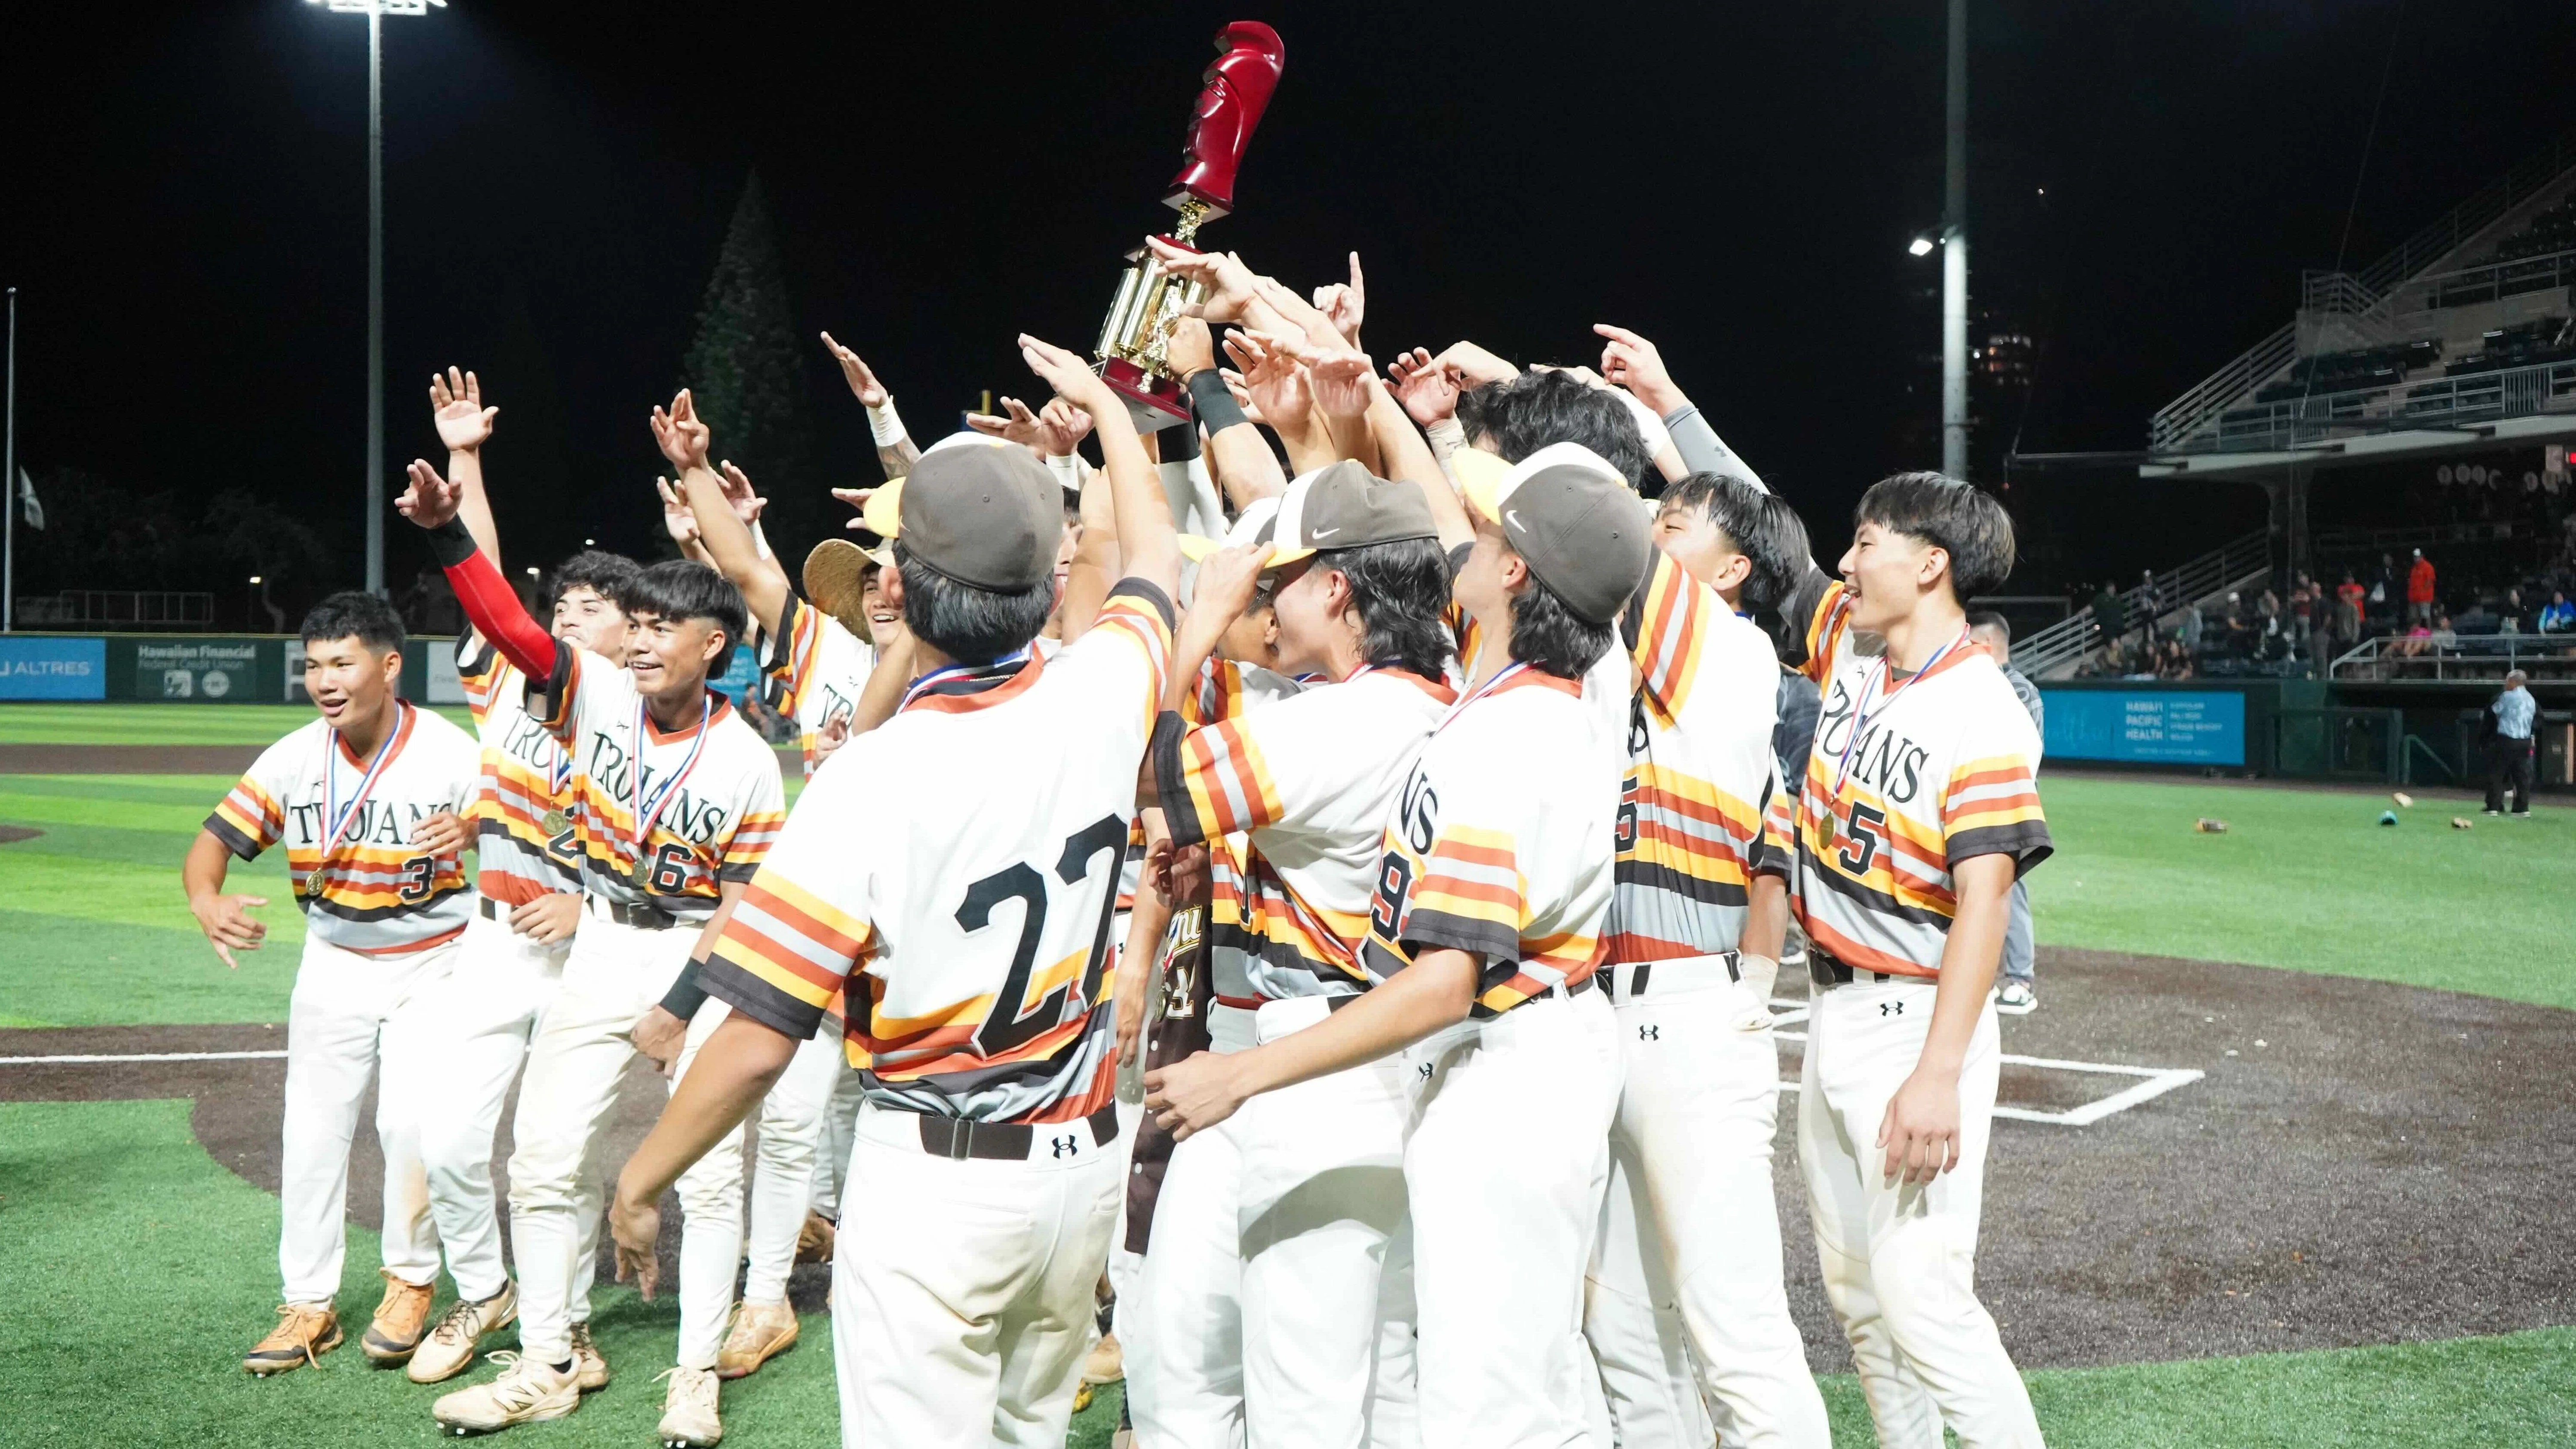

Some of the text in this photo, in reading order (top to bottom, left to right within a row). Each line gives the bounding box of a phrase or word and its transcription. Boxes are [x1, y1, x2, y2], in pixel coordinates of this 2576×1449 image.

[14, 661, 90, 676] ALTRES
[138, 645, 256, 659] Hawaiian Financial
[2125, 714, 2162, 726] PACIFIC
[2125, 728, 2163, 740] HEALTH
[1839, 801, 1886, 878] 5
[399, 855, 435, 905] 3
[649, 843, 696, 893] 6
[1369, 850, 1415, 945] 9
[954, 812, 1129, 1061] 27
